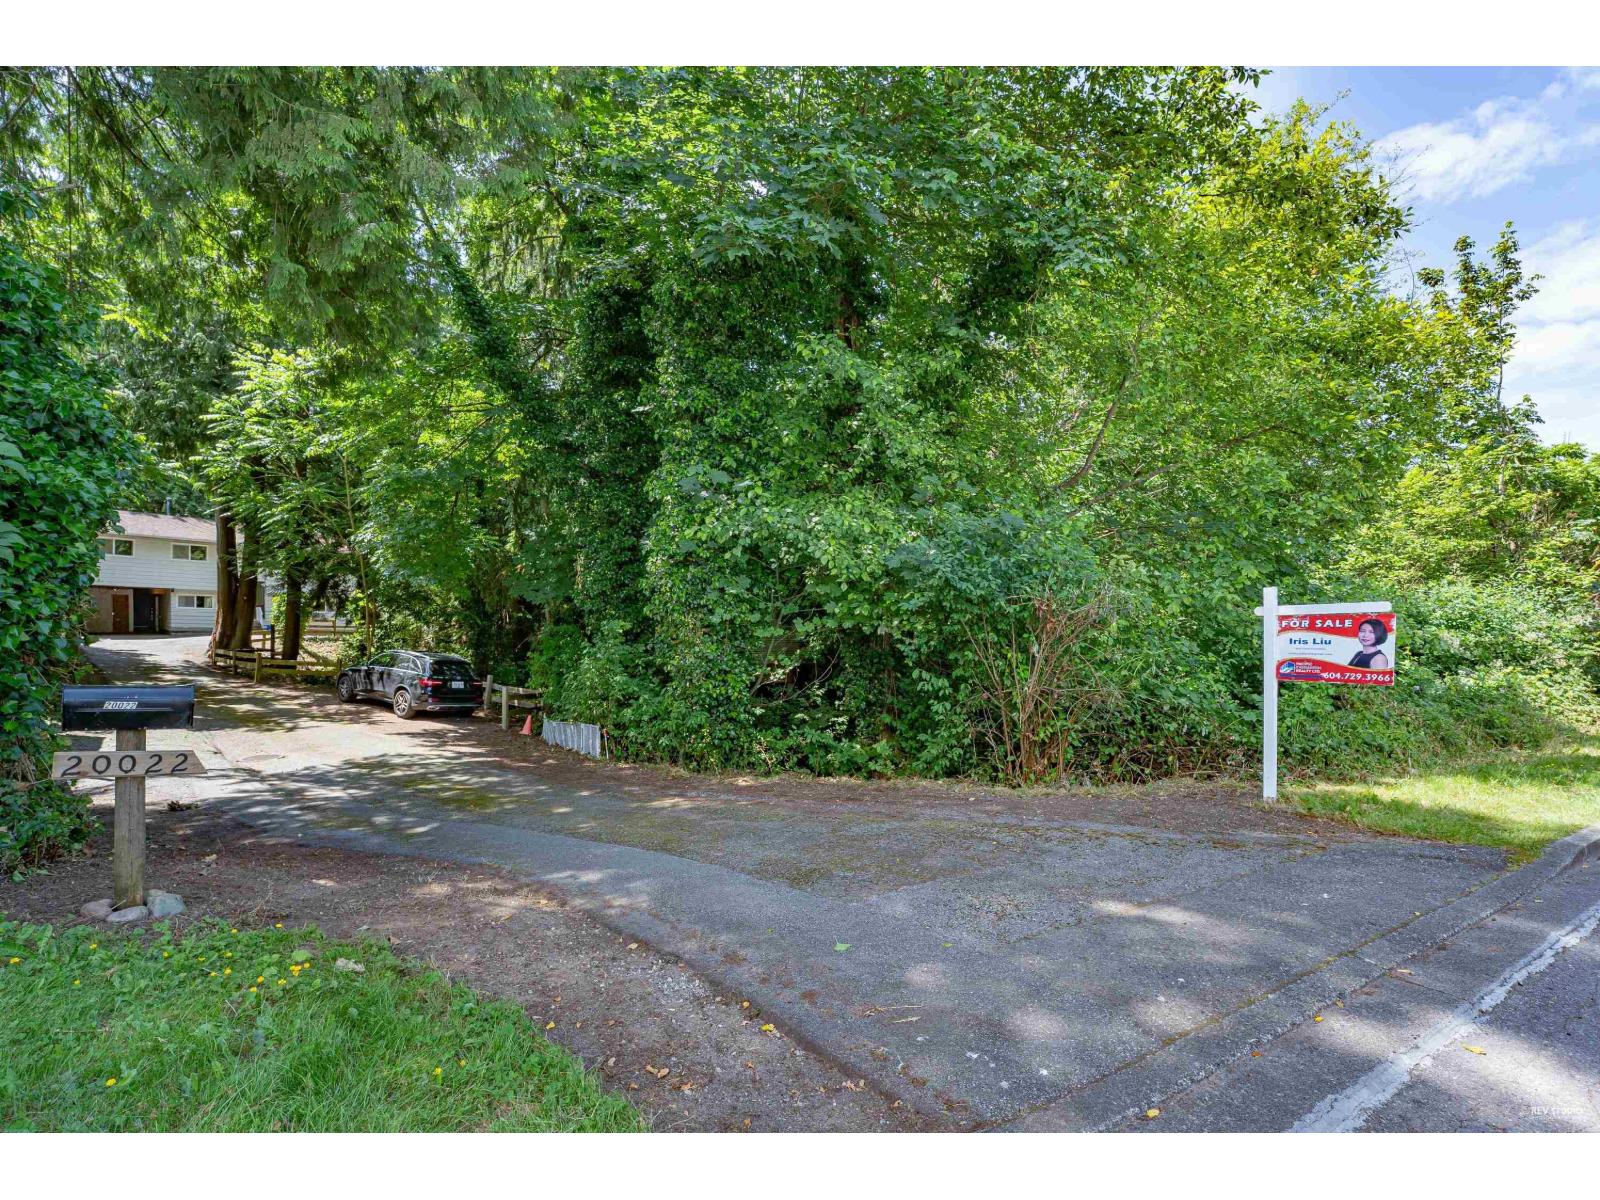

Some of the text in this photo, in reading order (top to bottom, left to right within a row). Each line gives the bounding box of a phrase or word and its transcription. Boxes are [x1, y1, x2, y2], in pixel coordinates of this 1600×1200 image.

[1282, 619, 1352, 627] FOR SALE
[1323, 672, 1391, 682] 604.729.3966
[103, 701, 138, 709] 20022
[61, 753, 188, 778] 20022
